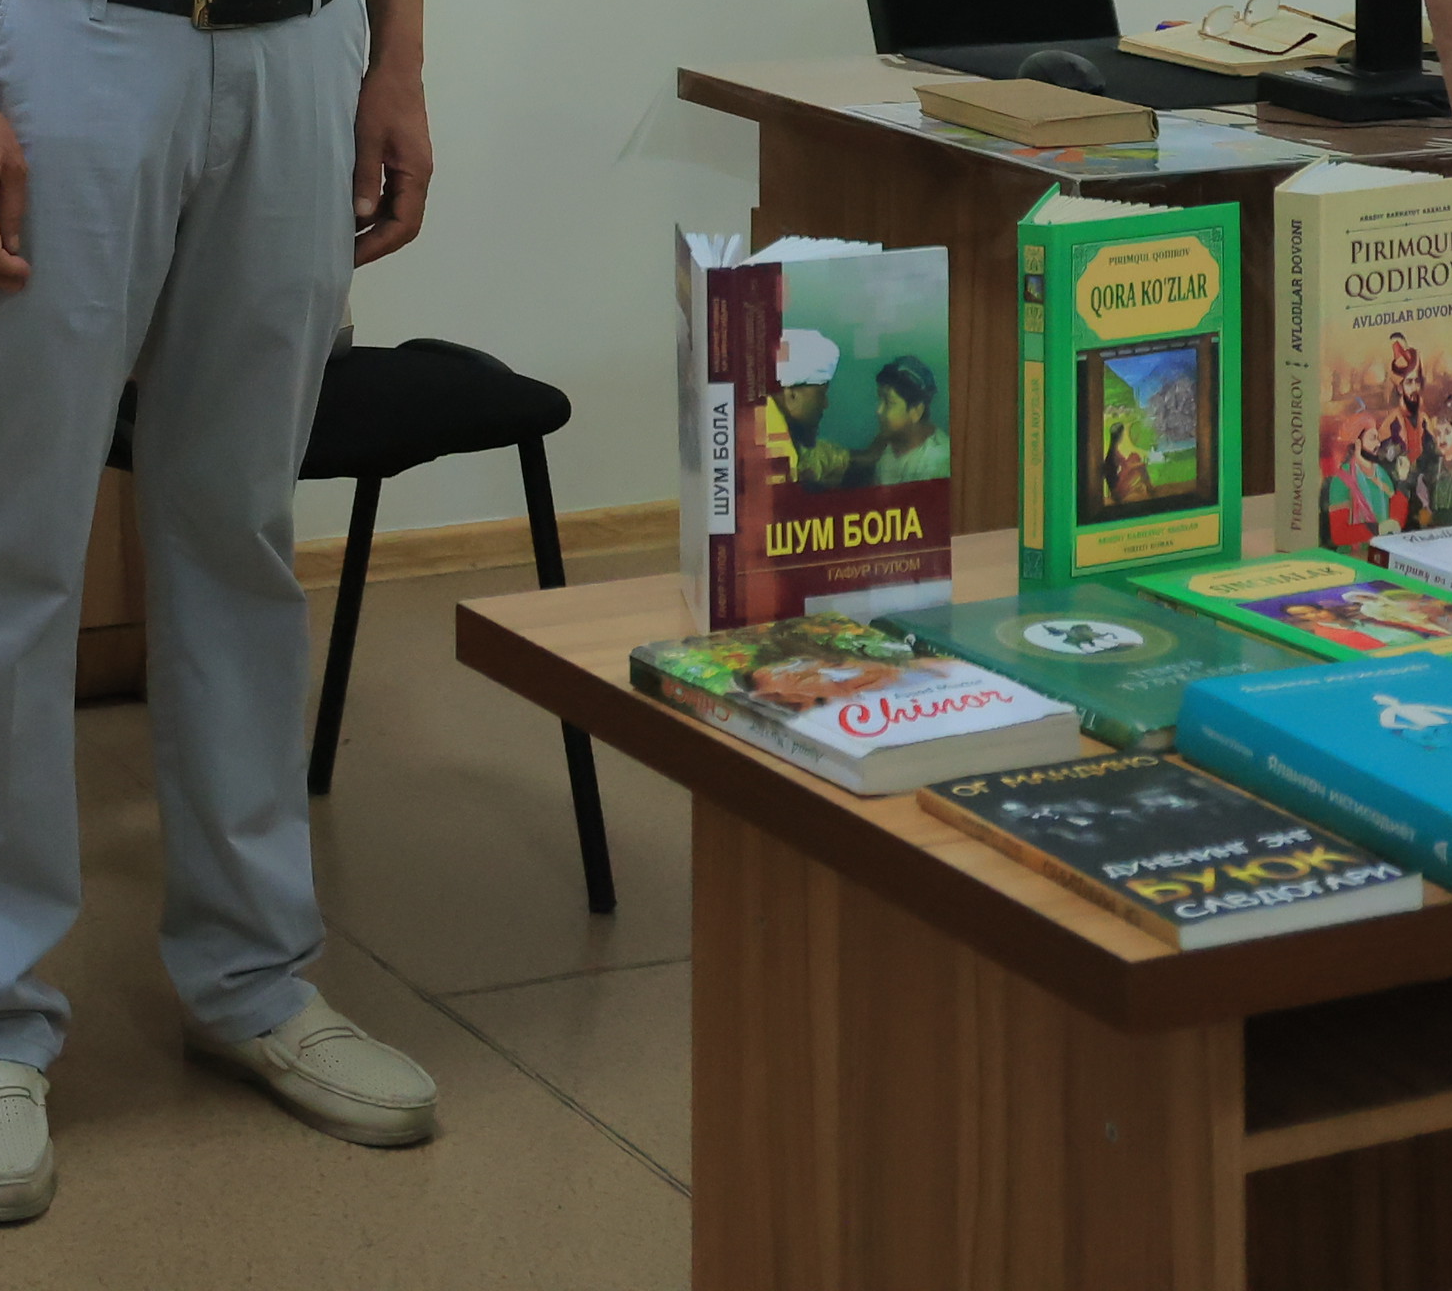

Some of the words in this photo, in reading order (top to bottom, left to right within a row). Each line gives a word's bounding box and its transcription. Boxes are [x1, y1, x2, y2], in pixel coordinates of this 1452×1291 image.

[1291, 220, 1303, 267] DOVONI
[1090, 281, 1137, 318] QORA
[1141, 273, 1208, 306] KO'ZLAR
[1291, 278, 1303, 352] AVLODLAR
[1352, 310, 1414, 329] AVLODLAR
[713, 401, 729, 458] БОЛА
[1291, 377, 1306, 455] QODIROV
[713, 461, 730, 516] ШУМ
[766, 515, 835, 557] ШУМ
[844, 507, 924, 549] БОЛА
[828, 563, 871, 582] ГАФУР
[838, 688, 1015, 738] Chinor
[951, 780, 990, 798] ОГ
[1000, 754, 1160, 788] МАНДИНО
[1126, 845, 1358, 904] БУЮК
[1174, 861, 1403, 919] САВДОГАРИ
